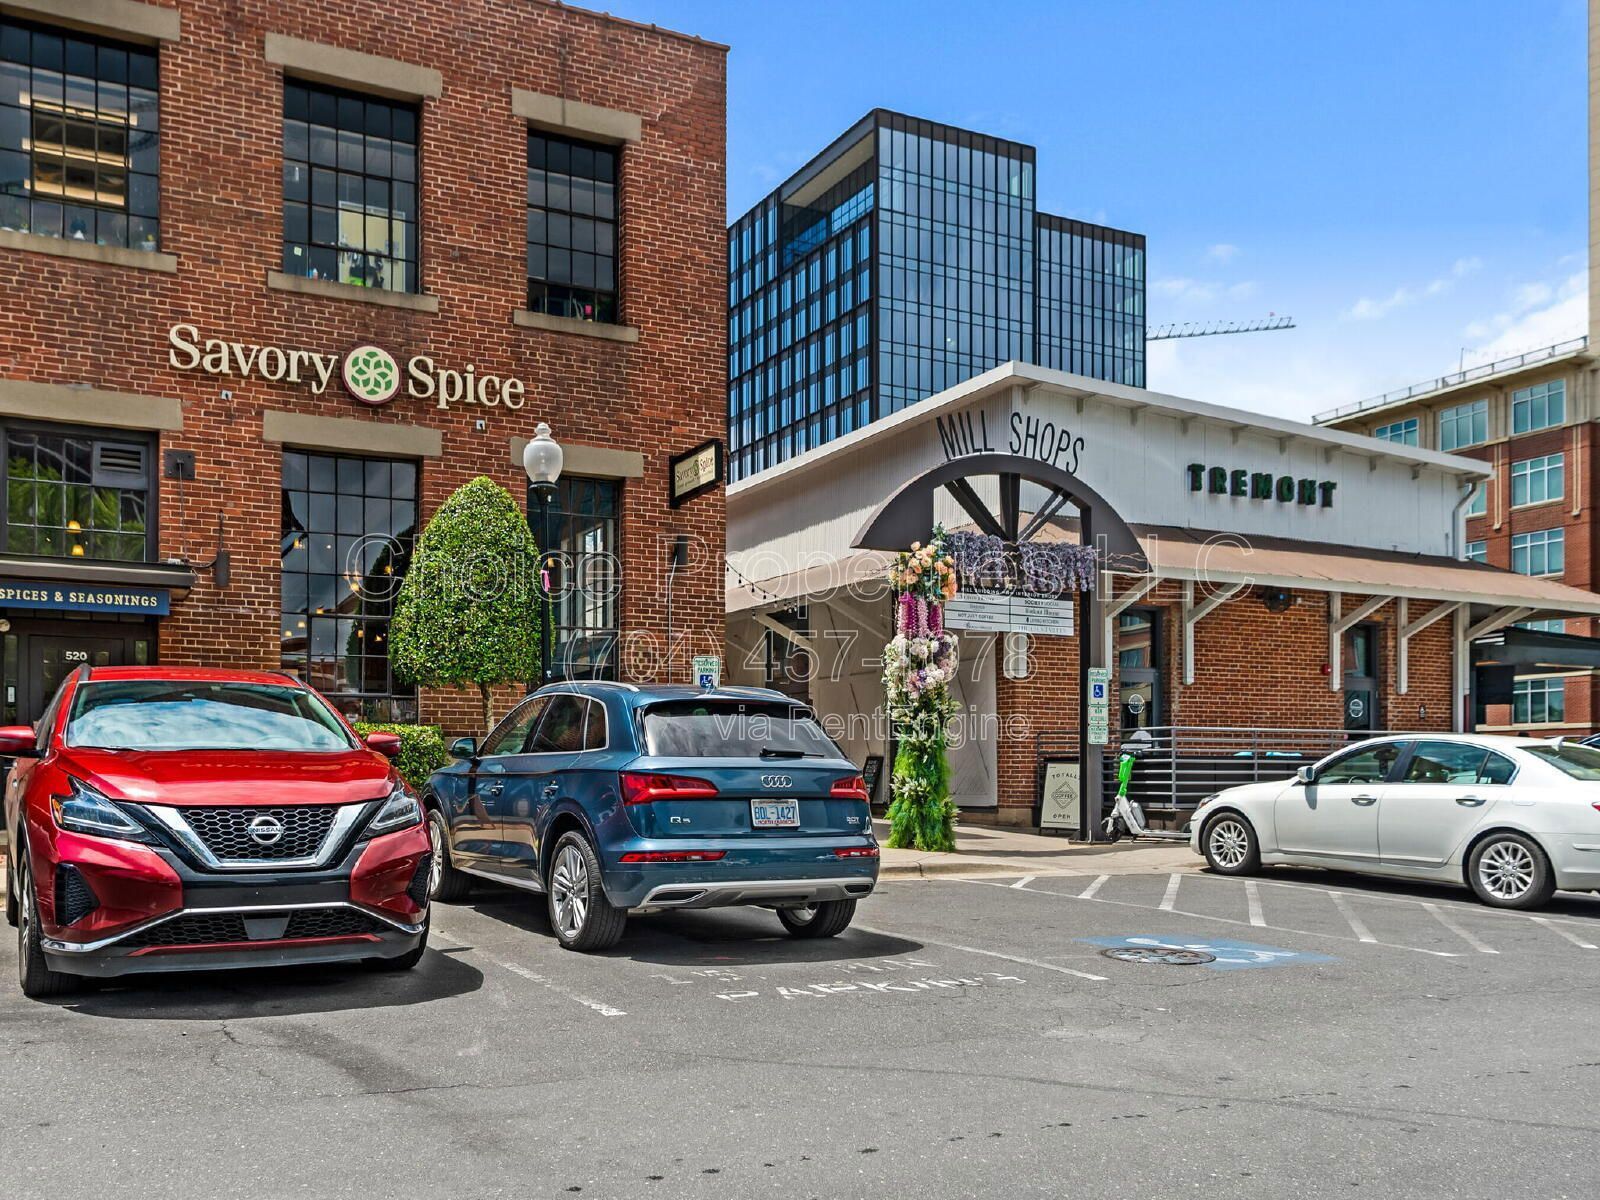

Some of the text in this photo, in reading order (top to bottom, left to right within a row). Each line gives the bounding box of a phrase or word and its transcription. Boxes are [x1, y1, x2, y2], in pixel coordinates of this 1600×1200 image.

[168, 322, 526, 411] Savory Spice
[936, 409, 1085, 475] MILL SHOPS
[1187, 463, 1337, 508] TREMONT
[0, 588, 158, 607] SPICES & SEASONINGS
[65, 651, 88, 661] 520
[1052, 772, 1080, 780] TOTALL
